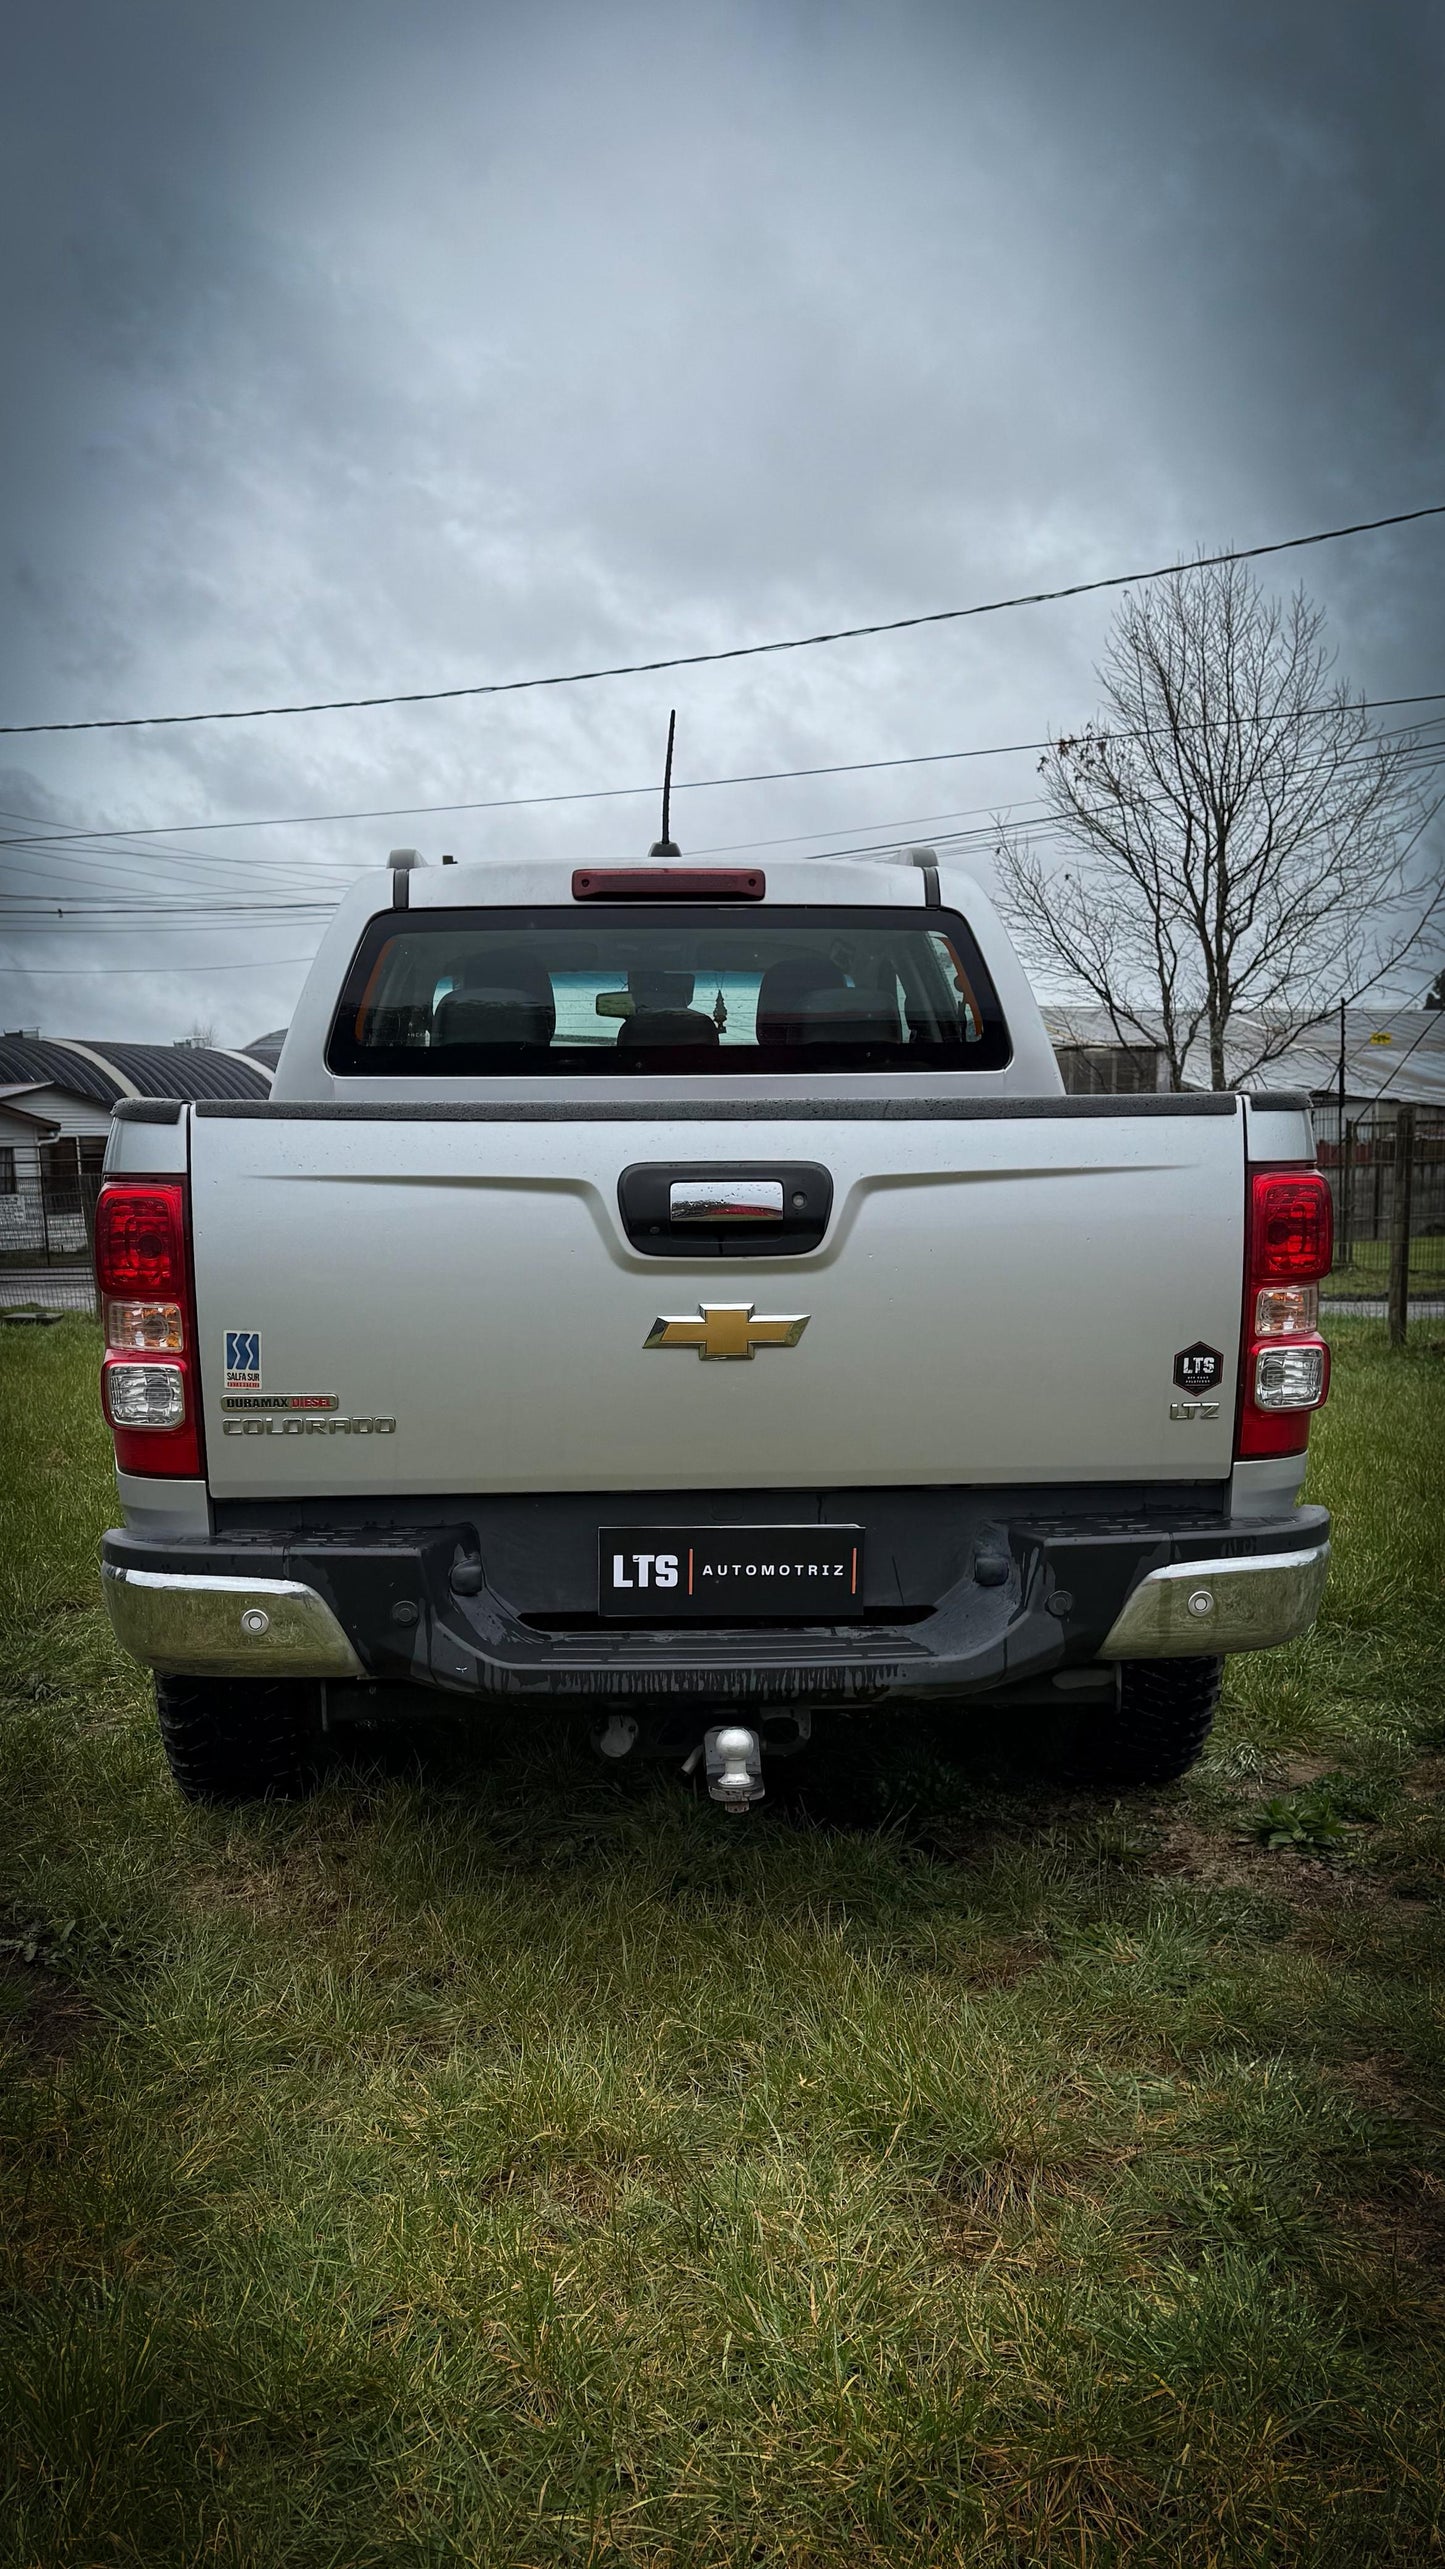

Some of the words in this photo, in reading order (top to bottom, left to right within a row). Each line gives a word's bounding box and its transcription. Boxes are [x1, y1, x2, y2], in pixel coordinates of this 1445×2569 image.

[1183, 1357, 1215, 1374] LTS
[226, 1372, 246, 1381] SALFA
[247, 1373, 260, 1382] SUR
[226, 1398, 289, 1408] DURAMAX
[291, 1398, 332, 1408] DIESEL
[1170, 1402, 1220, 1420] LTZ
[222, 1415, 397, 1436] COLORADO
[613, 1554, 679, 1588] LTS
[702, 1564, 844, 1576] AUTOMOTRIZ
